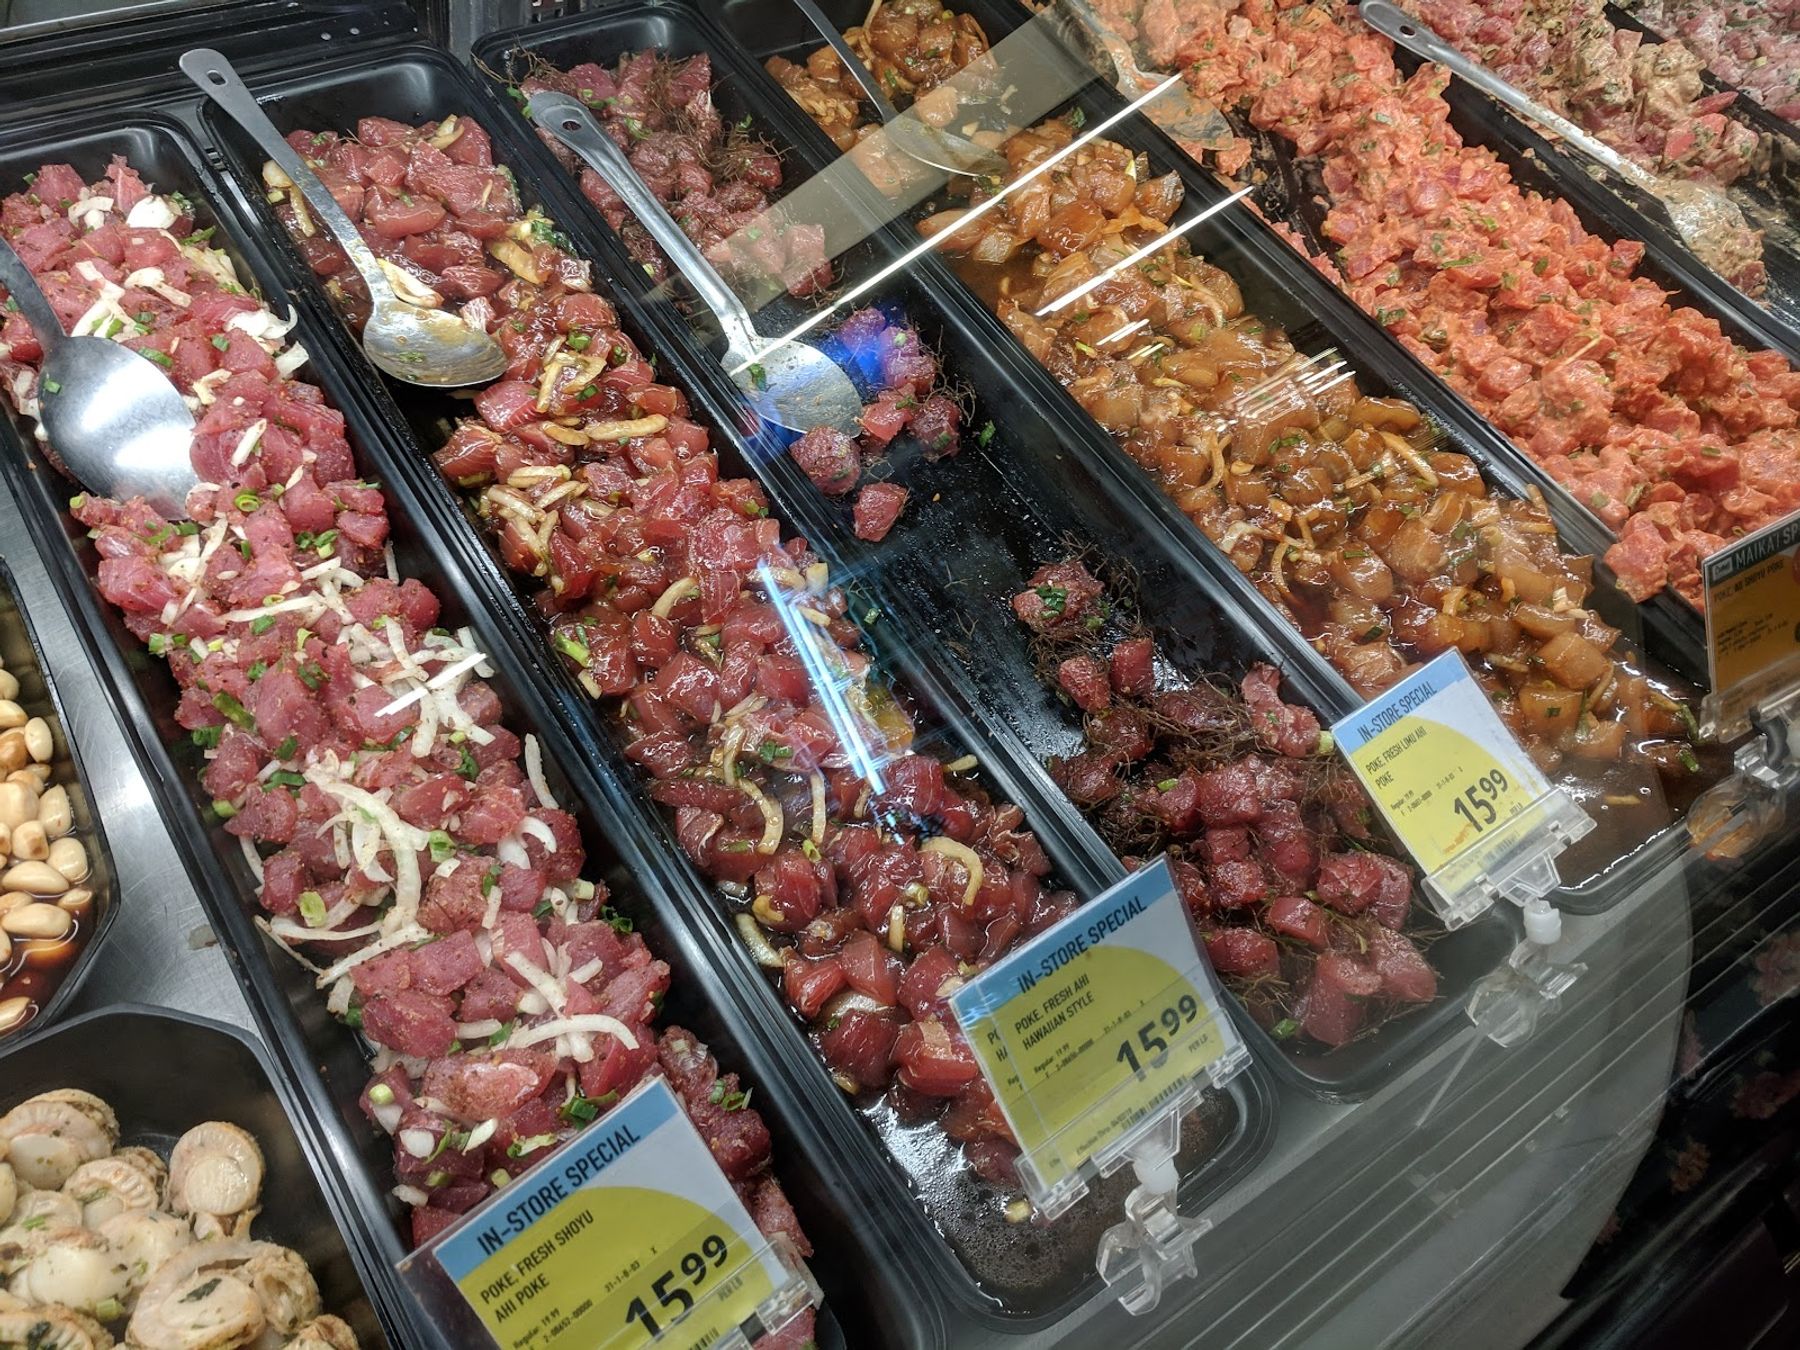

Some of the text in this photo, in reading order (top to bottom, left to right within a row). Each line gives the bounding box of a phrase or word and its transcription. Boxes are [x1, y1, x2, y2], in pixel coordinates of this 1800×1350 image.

[1782, 523, 1800, 545] SP
[1357, 681, 1438, 743] IN-STORE SPECIAL
[1382, 743, 1404, 764] FRESH
[1400, 731, 1418, 750] LIMU
[1414, 725, 1427, 740] AHI
[1375, 770, 1394, 789] POKE
[1017, 896, 1147, 994] IN-STORE SPECIAL
[1022, 991, 1095, 1050] HAWAIIAN STYLE
[1042, 986, 1073, 1013] FRESH
[1073, 973, 1090, 993] AHI
[477, 1124, 641, 1256] IN-STORE SPECIAL
[516, 1240, 557, 1276] FRESH
[554, 1209, 594, 1246] SHOYU
[495, 1273, 550, 1324] AHI POKE
